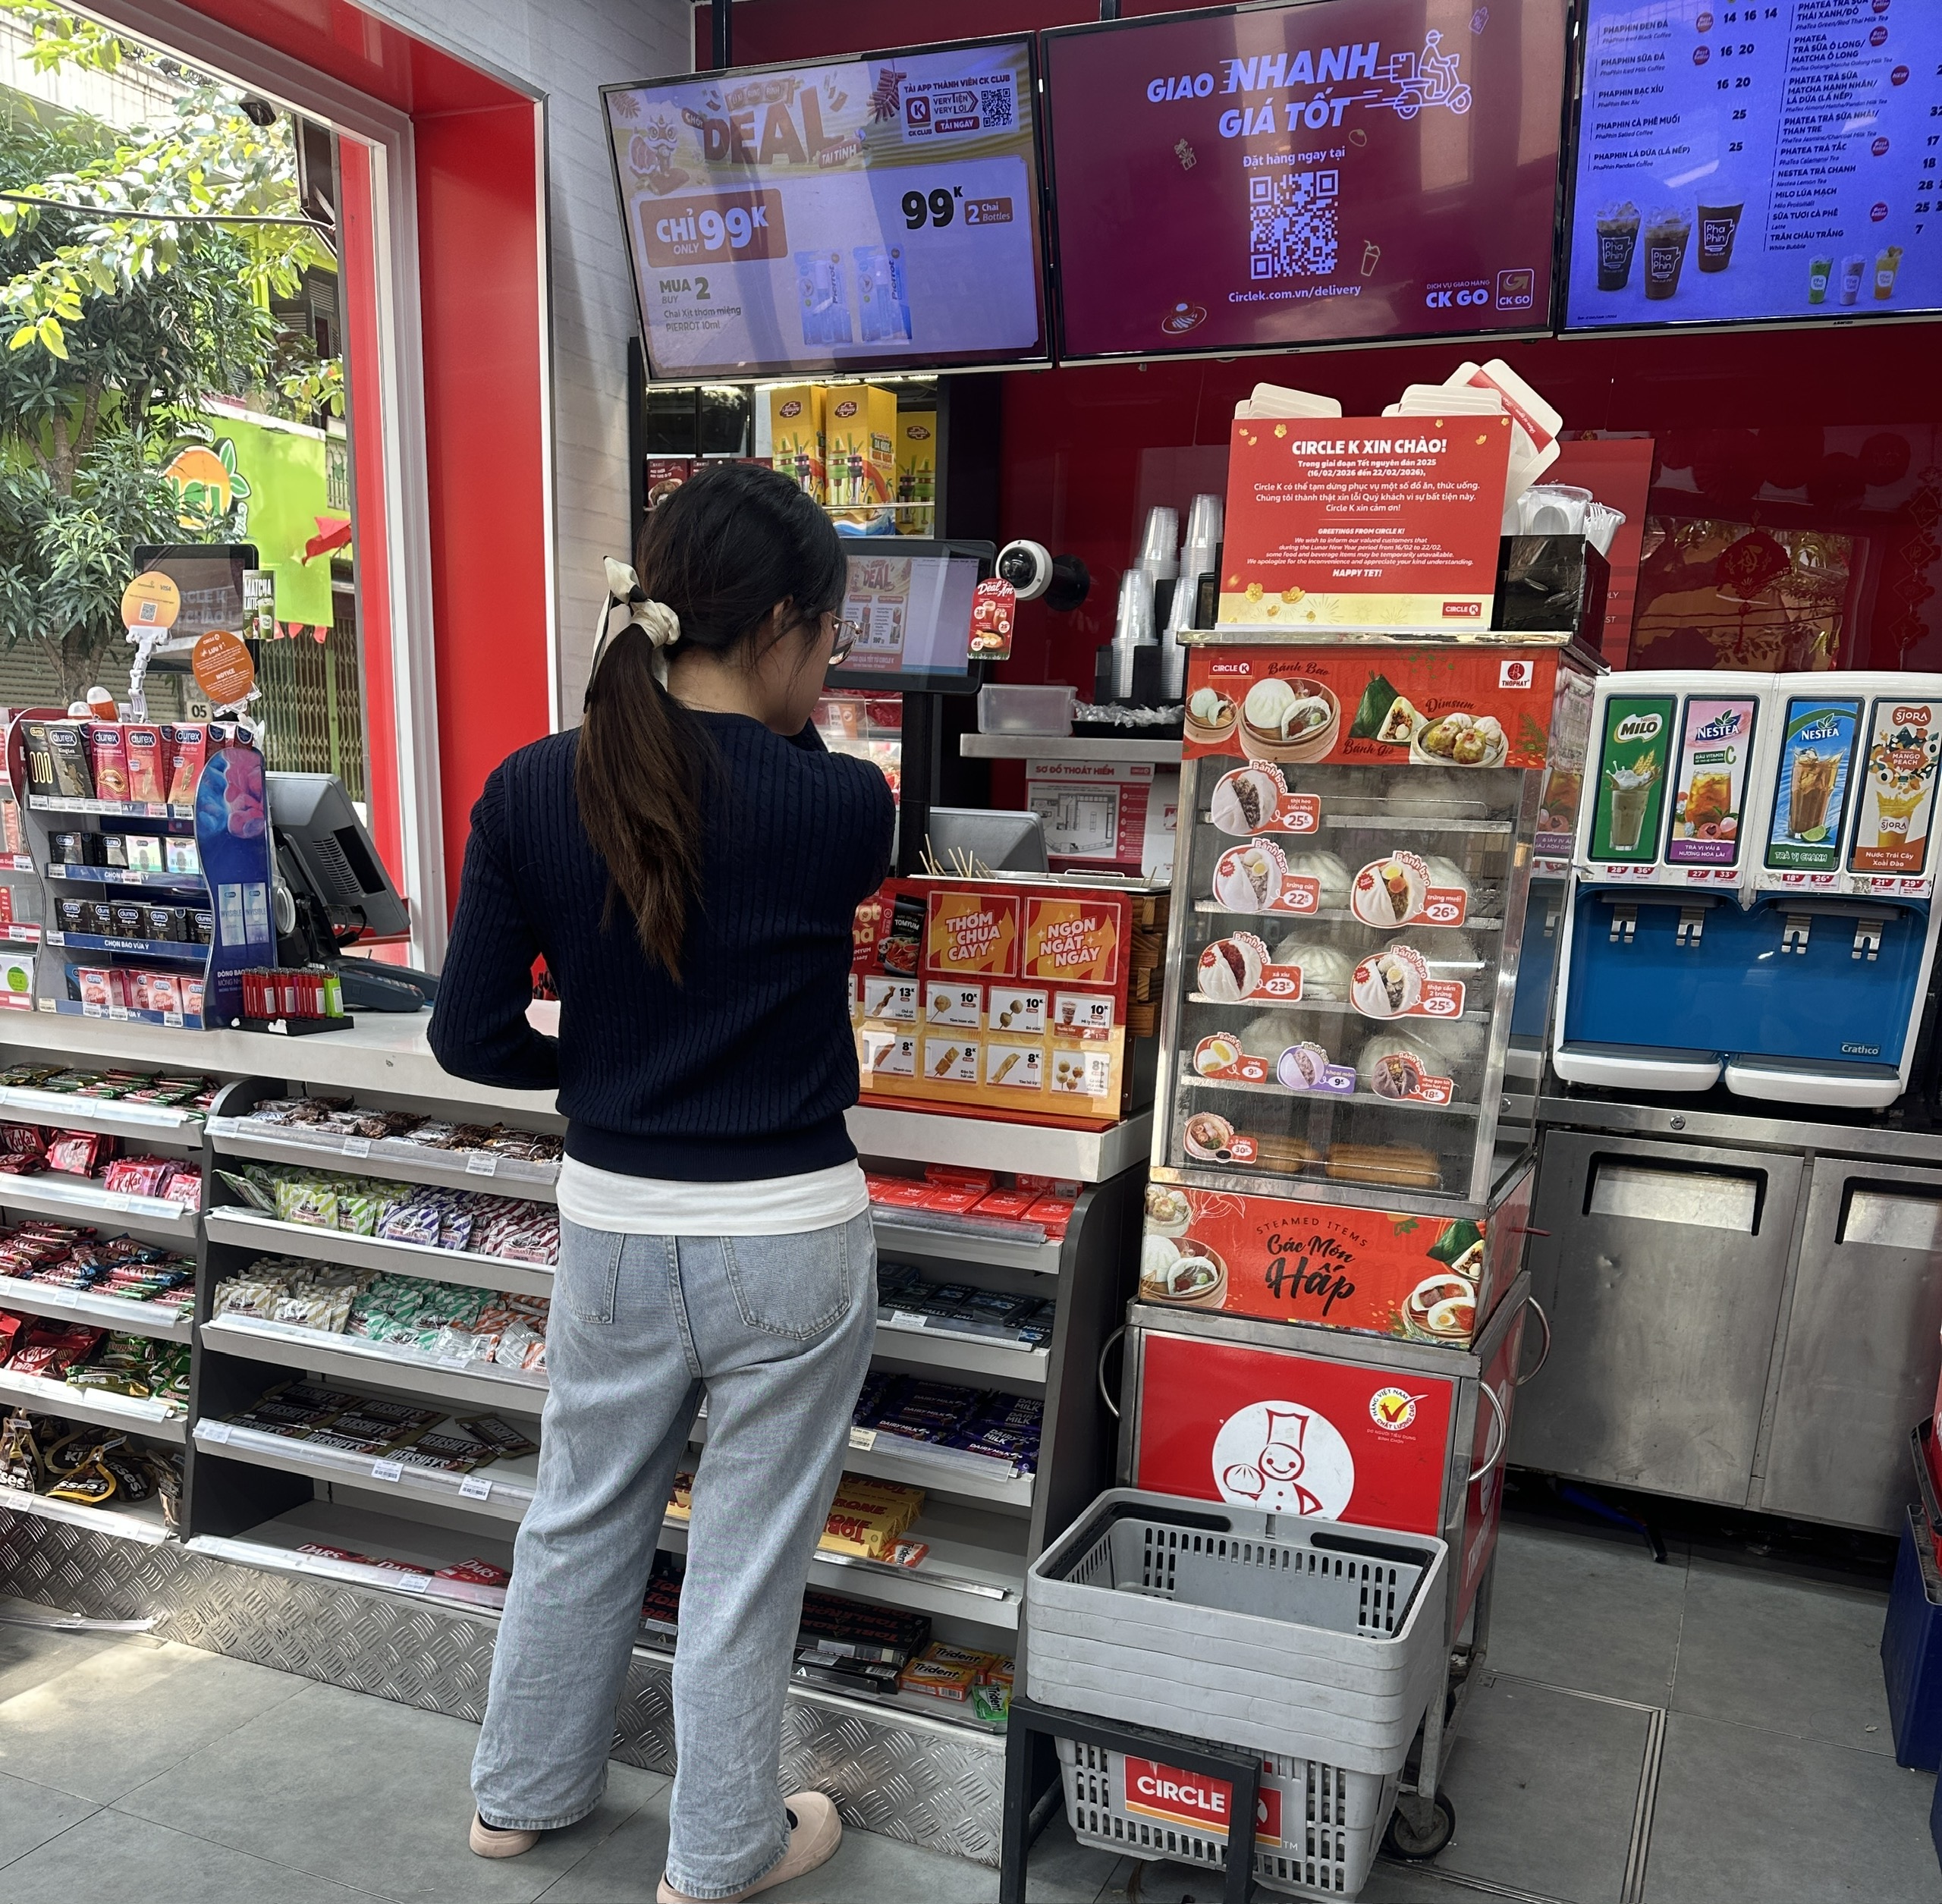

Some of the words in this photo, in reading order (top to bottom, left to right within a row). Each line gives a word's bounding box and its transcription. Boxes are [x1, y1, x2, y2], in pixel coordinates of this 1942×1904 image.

[1792, 55, 1825, 64] MATCHA
[1836, 50, 1858, 59] LONG
[1147, 73, 1214, 102] GIAO
[1227, 42, 1379, 93] NHANH
[933, 81, 959, 90] THÀNH
[960, 77, 978, 87] VIÊN
[979, 77, 989, 86] CK
[991, 74, 1010, 83] CLUB
[1717, 79, 1729, 90] 16
[1736, 77, 1750, 87] 20
[953, 93, 968, 103] TIỆN
[1634, 89, 1649, 97] BẠC
[1219, 97, 1276, 138] GIÁ
[1285, 87, 1352, 131] TỐT
[703, 86, 844, 165] DEAL
[1596, 121, 1630, 130] PHAPHIN
[1643, 118, 1658, 126] PHÊ
[1660, 114, 1680, 124] MUỐI
[1733, 109, 1746, 120] 25
[1594, 152, 1627, 160] PHAPHIN
[1729, 142, 1742, 152] 25
[1243, 155, 1263, 170] Đặt
[1266, 152, 1295, 167] hàng
[1298, 150, 1327, 162] ngay
[1329, 146, 1345, 161] tại
[1778, 168, 1808, 178] NESTEA
[1810, 165, 1826, 174] TRÀ
[1827, 165, 1856, 174] CHANH
[1923, 158, 1936, 168] 18
[1796, 188, 1812, 197] LÚA
[1814, 188, 1837, 197] MẠCH
[968, 205, 979, 222] 2
[982, 202, 998, 212] Chai
[983, 212, 1010, 221] Bottles
[656, 208, 696, 242] CHỈ
[1707, 224, 1726, 234] Pha
[1707, 233, 1727, 242] Phin
[673, 243, 699, 254] ONLY
[659, 279, 692, 293] MUA
[695, 277, 711, 300] 2
[1228, 284, 1362, 303] Circlek.com.vn/delivery
[662, 296, 678, 304] BUY
[1426, 290, 1453, 308] CK
[1456, 288, 1488, 305] GO
[1499, 296, 1513, 306] CK
[1515, 294, 1530, 304] GO
[665, 309, 680, 319] Chai
[682, 309, 693, 319] Xịt
[694, 307, 715, 316] thơm
[717, 306, 741, 316] miệng
[666, 322, 699, 332] PIERROT
[702, 320, 720, 330] 10ml
[1292, 441, 1346, 454] CIRCLE
[1348, 441, 1361, 454] K
[1362, 440, 1391, 454] XIN
[1394, 436, 1447, 454] CHÀO!
[1337, 460, 1356, 468] đoạn
[1372, 460, 1399, 468] nguyên
[1308, 469, 1356, 477] (16/02/2026
[1357, 468, 1372, 476] đến
[244, 579, 272, 598] MATCHA
[978, 583, 1000, 595] Deal
[1212, 664, 1238, 673] CIRCLE
[1239, 663, 1249, 674] K
[1268, 664, 1302, 675] Bánh
[1306, 662, 1329, 676] Bao
[192, 705, 207, 718] 05
[1426, 699, 1475, 712] Dimsum
[1896, 711, 1928, 722] SJORA
[1620, 724, 1658, 736] MILO
[1697, 725, 1739, 739] NESTEA
[1802, 729, 1840, 740] NESTEA
[52, 734, 75, 743] durex
[95, 733, 118, 743] durex
[131, 734, 153, 744] durex
[1049, 764, 1062, 773] ĐỒ
[1064, 765, 1092, 774] THOÁT
[1881, 821, 1906, 829] SJORA
[895, 919, 919, 931] TOMYUM
[946, 911, 993, 932] THƠM
[1048, 918, 1096, 938] NGON
[957, 926, 1001, 945] CHUA
[105, 940, 121, 948] CHỌN
[949, 941, 990, 960] CAYY
[1055, 944, 1100, 966] NGÂY
[1841, 1045, 1879, 1055] Crathco
[116, 1172, 143, 1191] KitKat
[1256, 1217, 1319, 1234] STEAMED
[1328, 1221, 1368, 1246] ITEMS
[1267, 1234, 1306, 1255] Các
[1308, 1236, 1356, 1263] Món
[1265, 1256, 1355, 1316] Hấp
[1023, 1324, 1052, 1333] HALLS
[1377, 1389, 1391, 1397] VIỆT
[1393, 1390, 1408, 1400] NAM
[879, 1421, 900, 1430] DAIRY
[458, 1560, 500, 1577] DARS
[913, 1663, 960, 1678] Trident
[1136, 1774, 1226, 1814] CIRCLE
